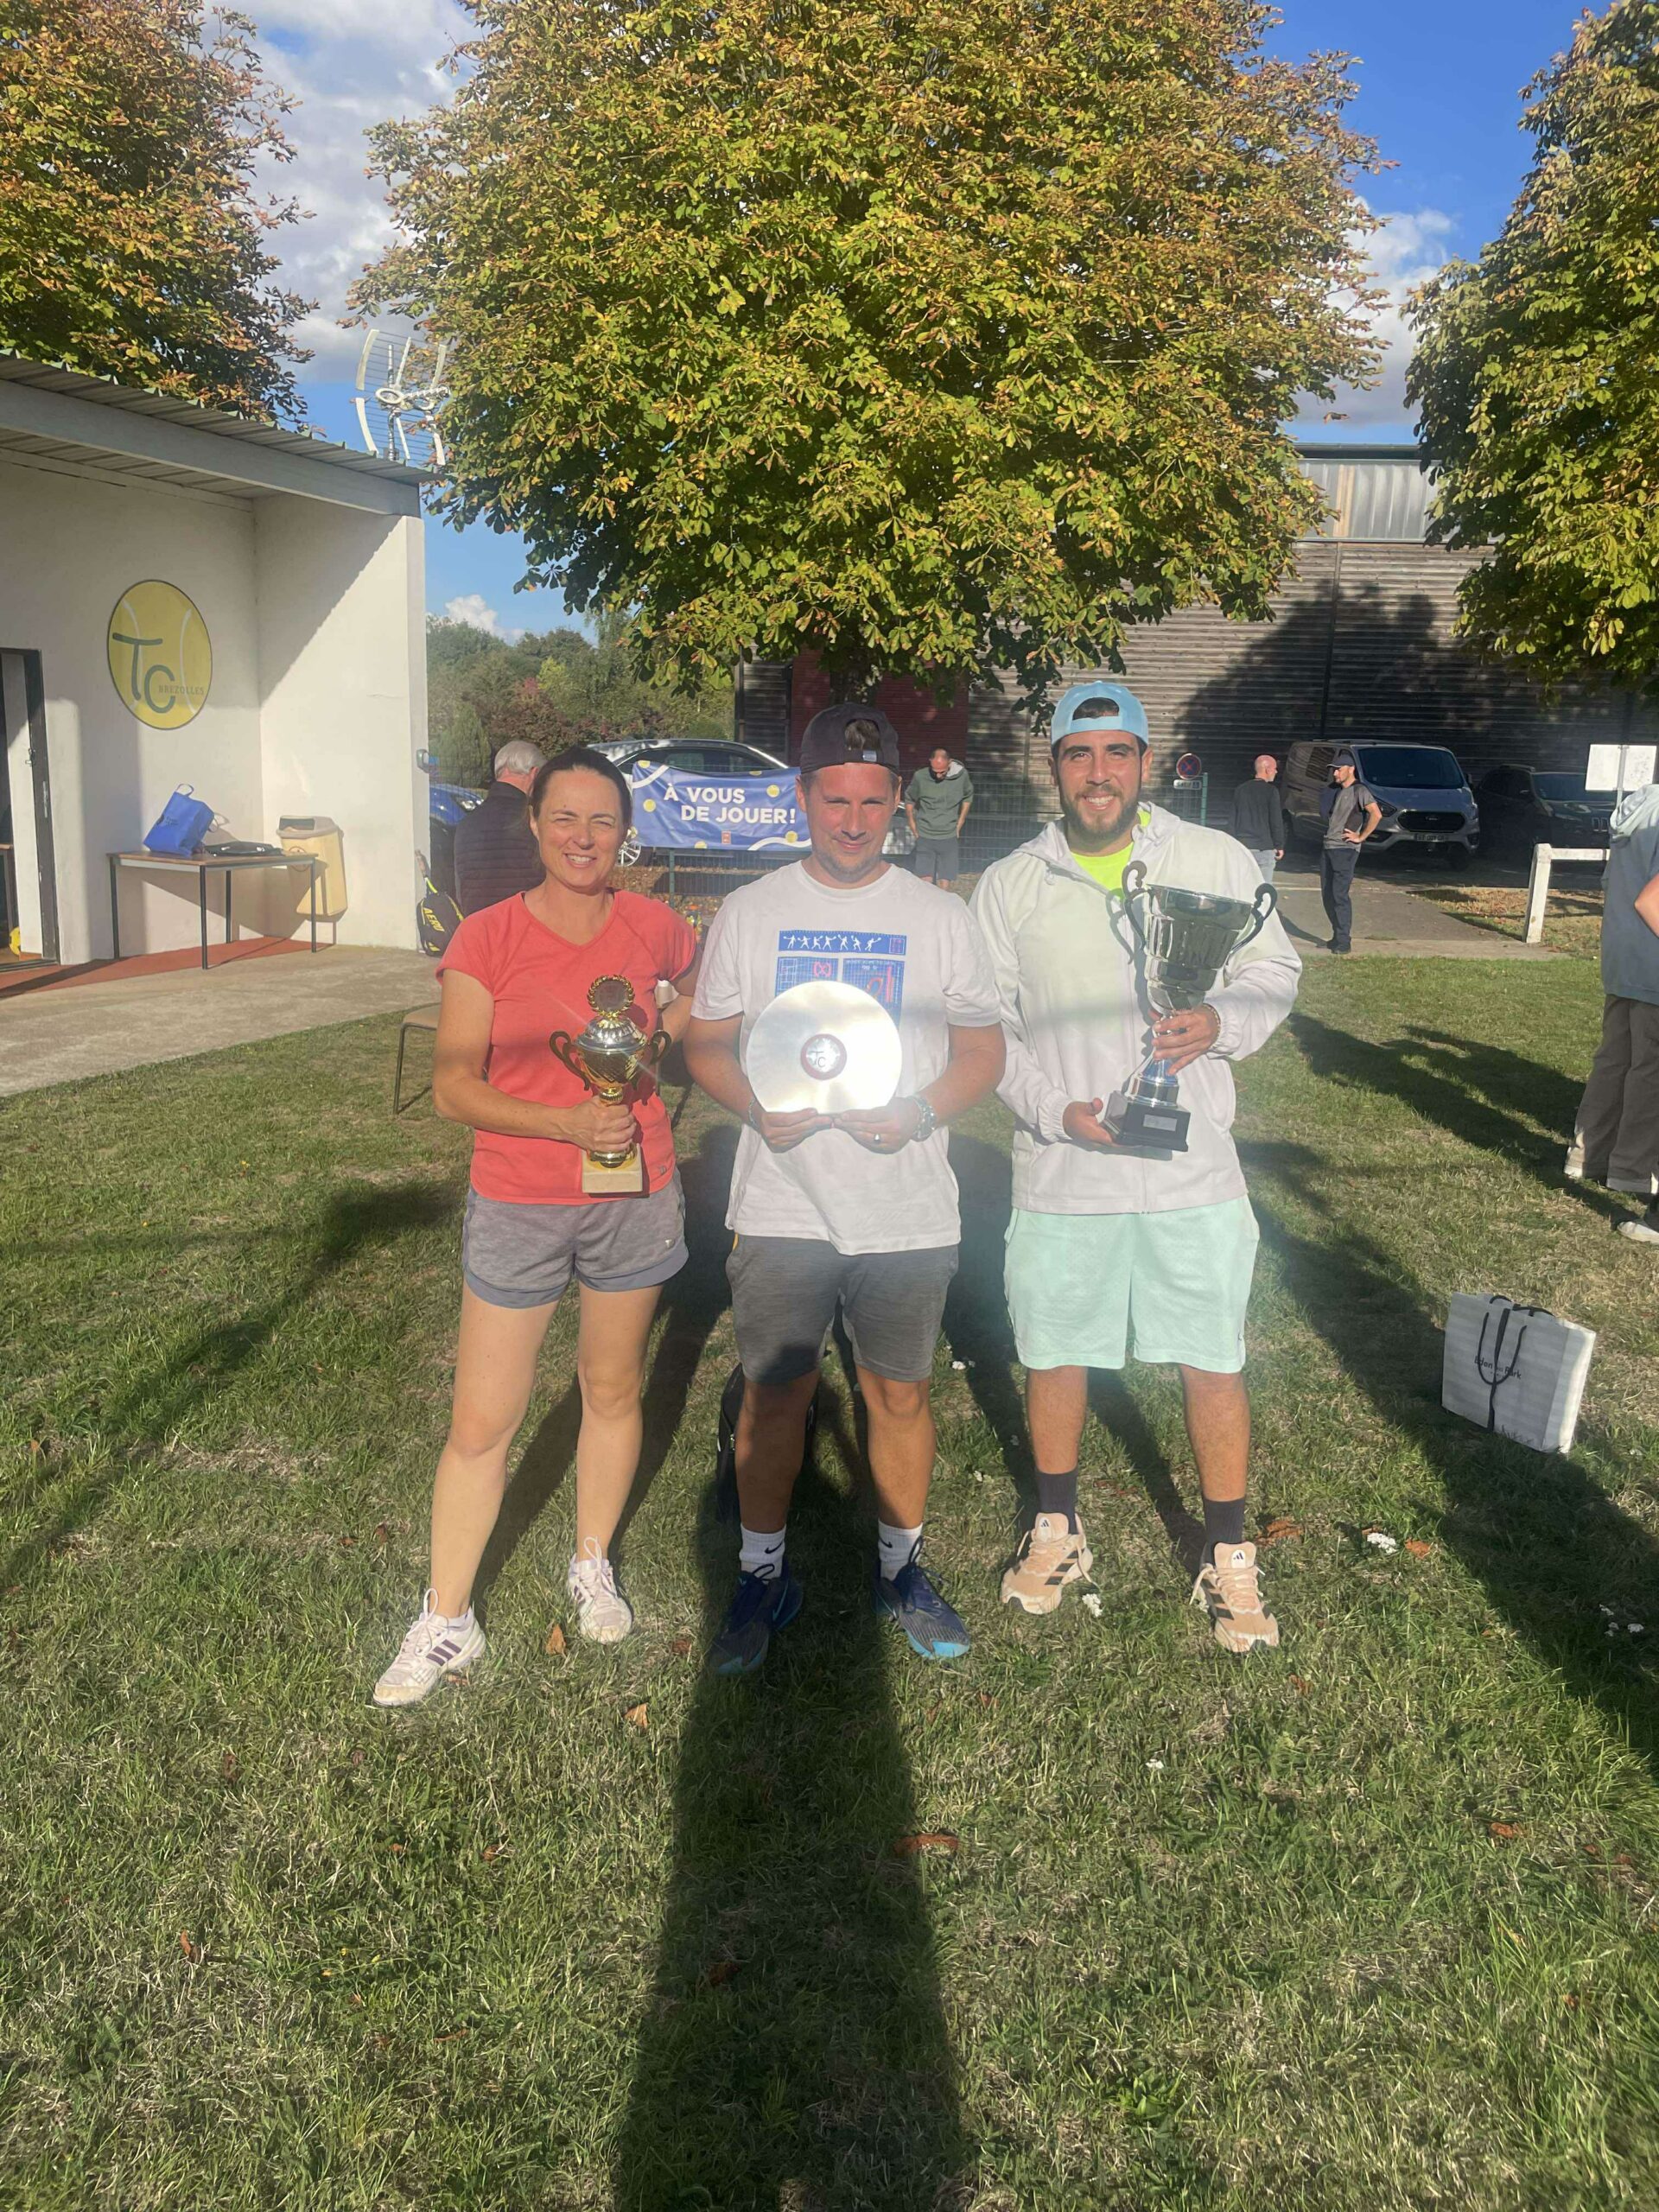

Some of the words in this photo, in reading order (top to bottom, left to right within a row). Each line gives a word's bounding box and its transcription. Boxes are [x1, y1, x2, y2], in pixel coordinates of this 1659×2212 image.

[112, 632, 175, 714] TC
[664, 783, 679, 802] À
[686, 787, 746, 804] VOUS
[681, 804, 709, 822] DE
[715, 807, 796, 824] JOUER!
